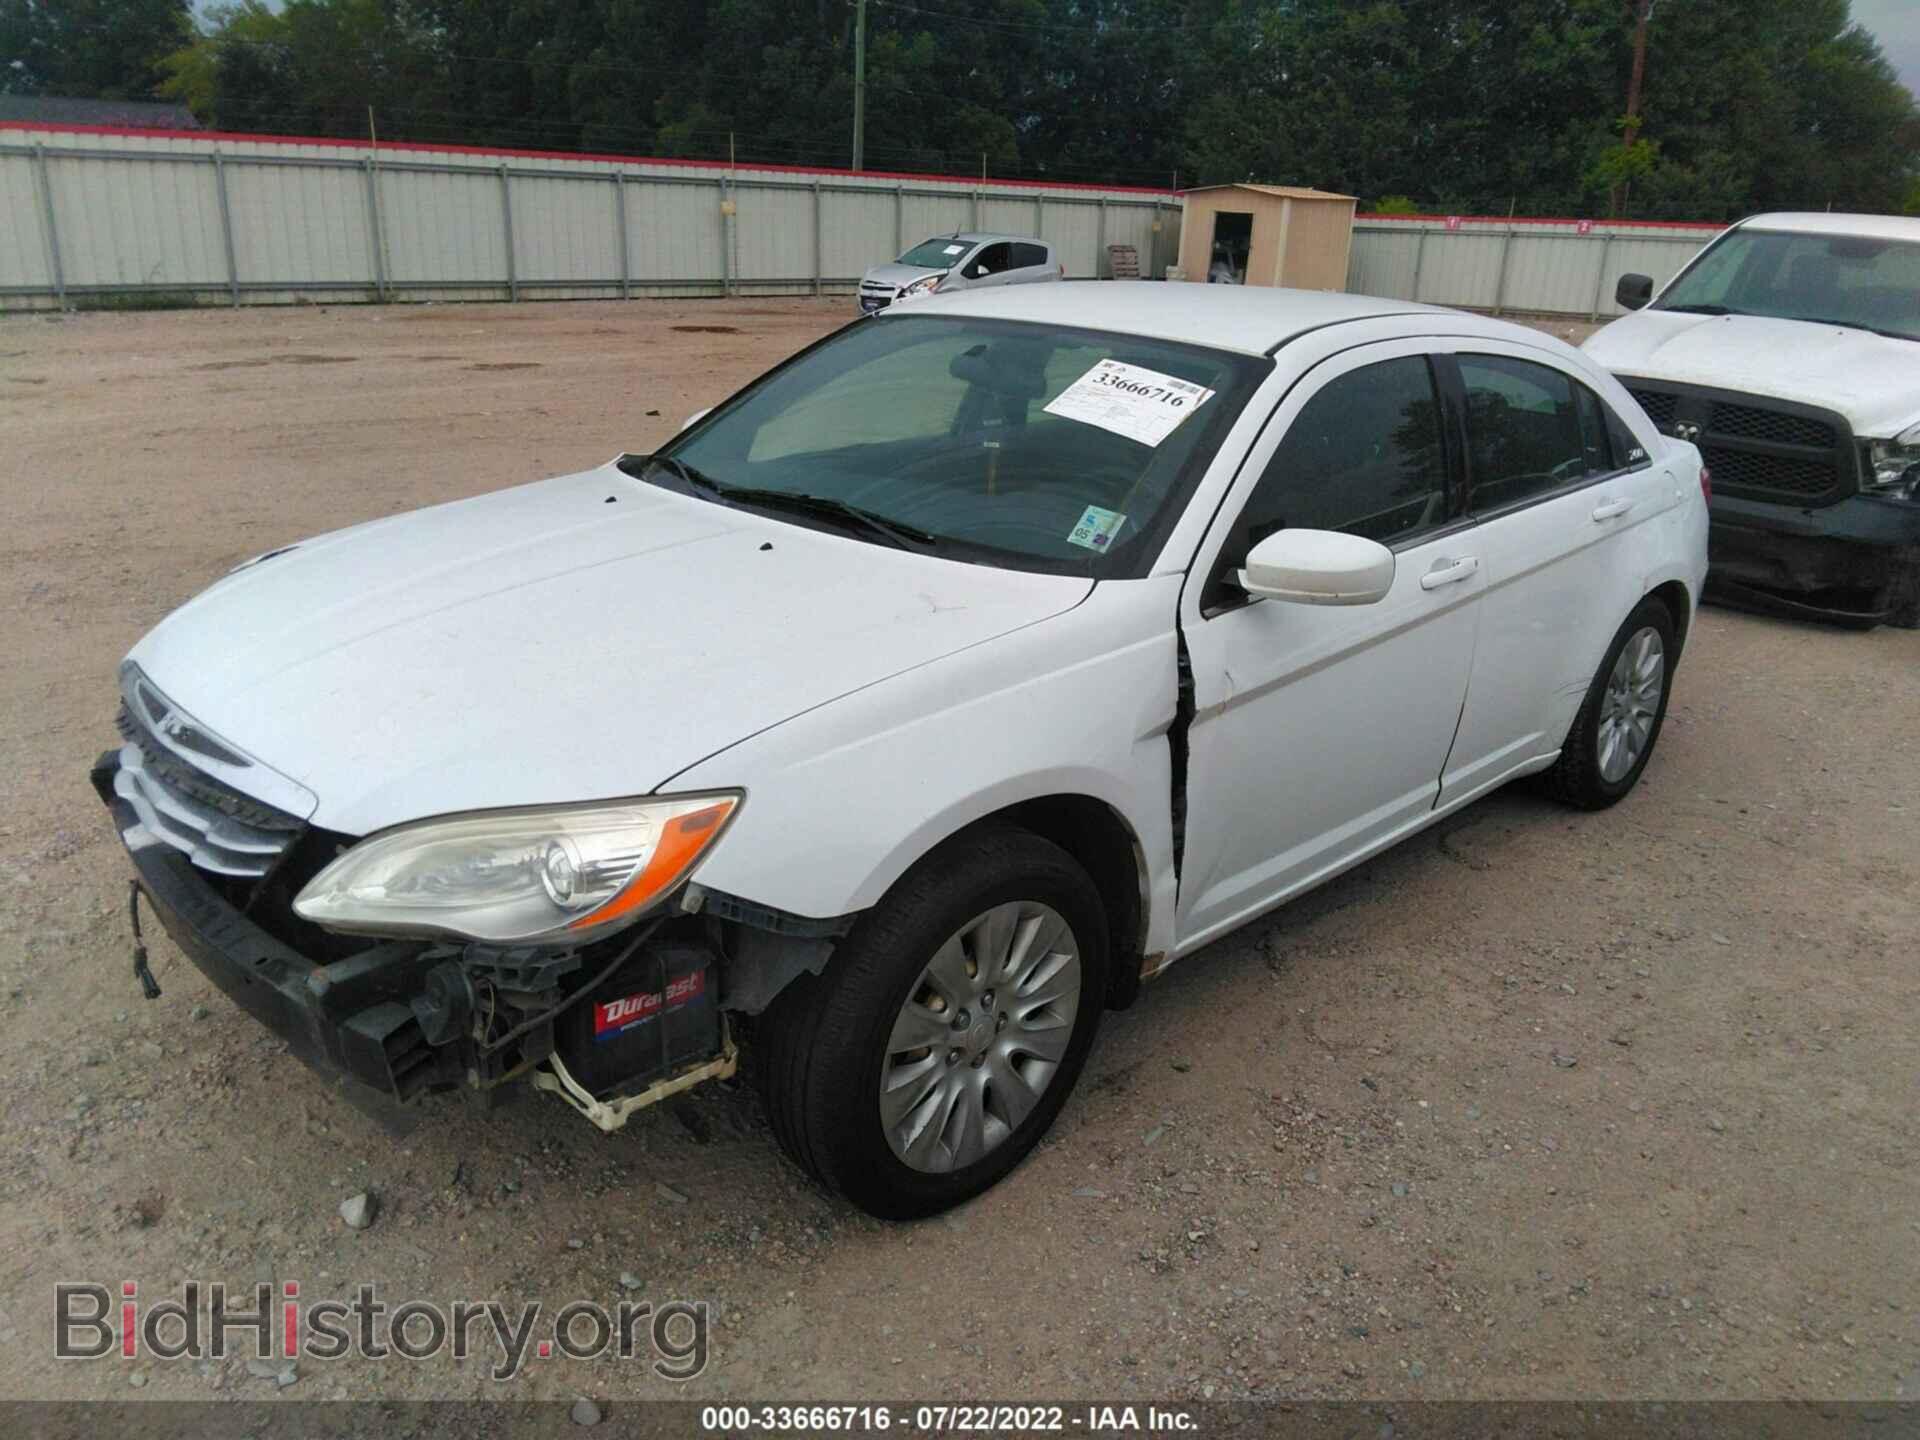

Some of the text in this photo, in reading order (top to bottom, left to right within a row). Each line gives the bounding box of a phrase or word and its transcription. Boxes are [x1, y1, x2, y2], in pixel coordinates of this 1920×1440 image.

[1092, 372, 1184, 407] 33666716
[1075, 528, 1091, 540] 05
[603, 971, 698, 1023] Duraast
